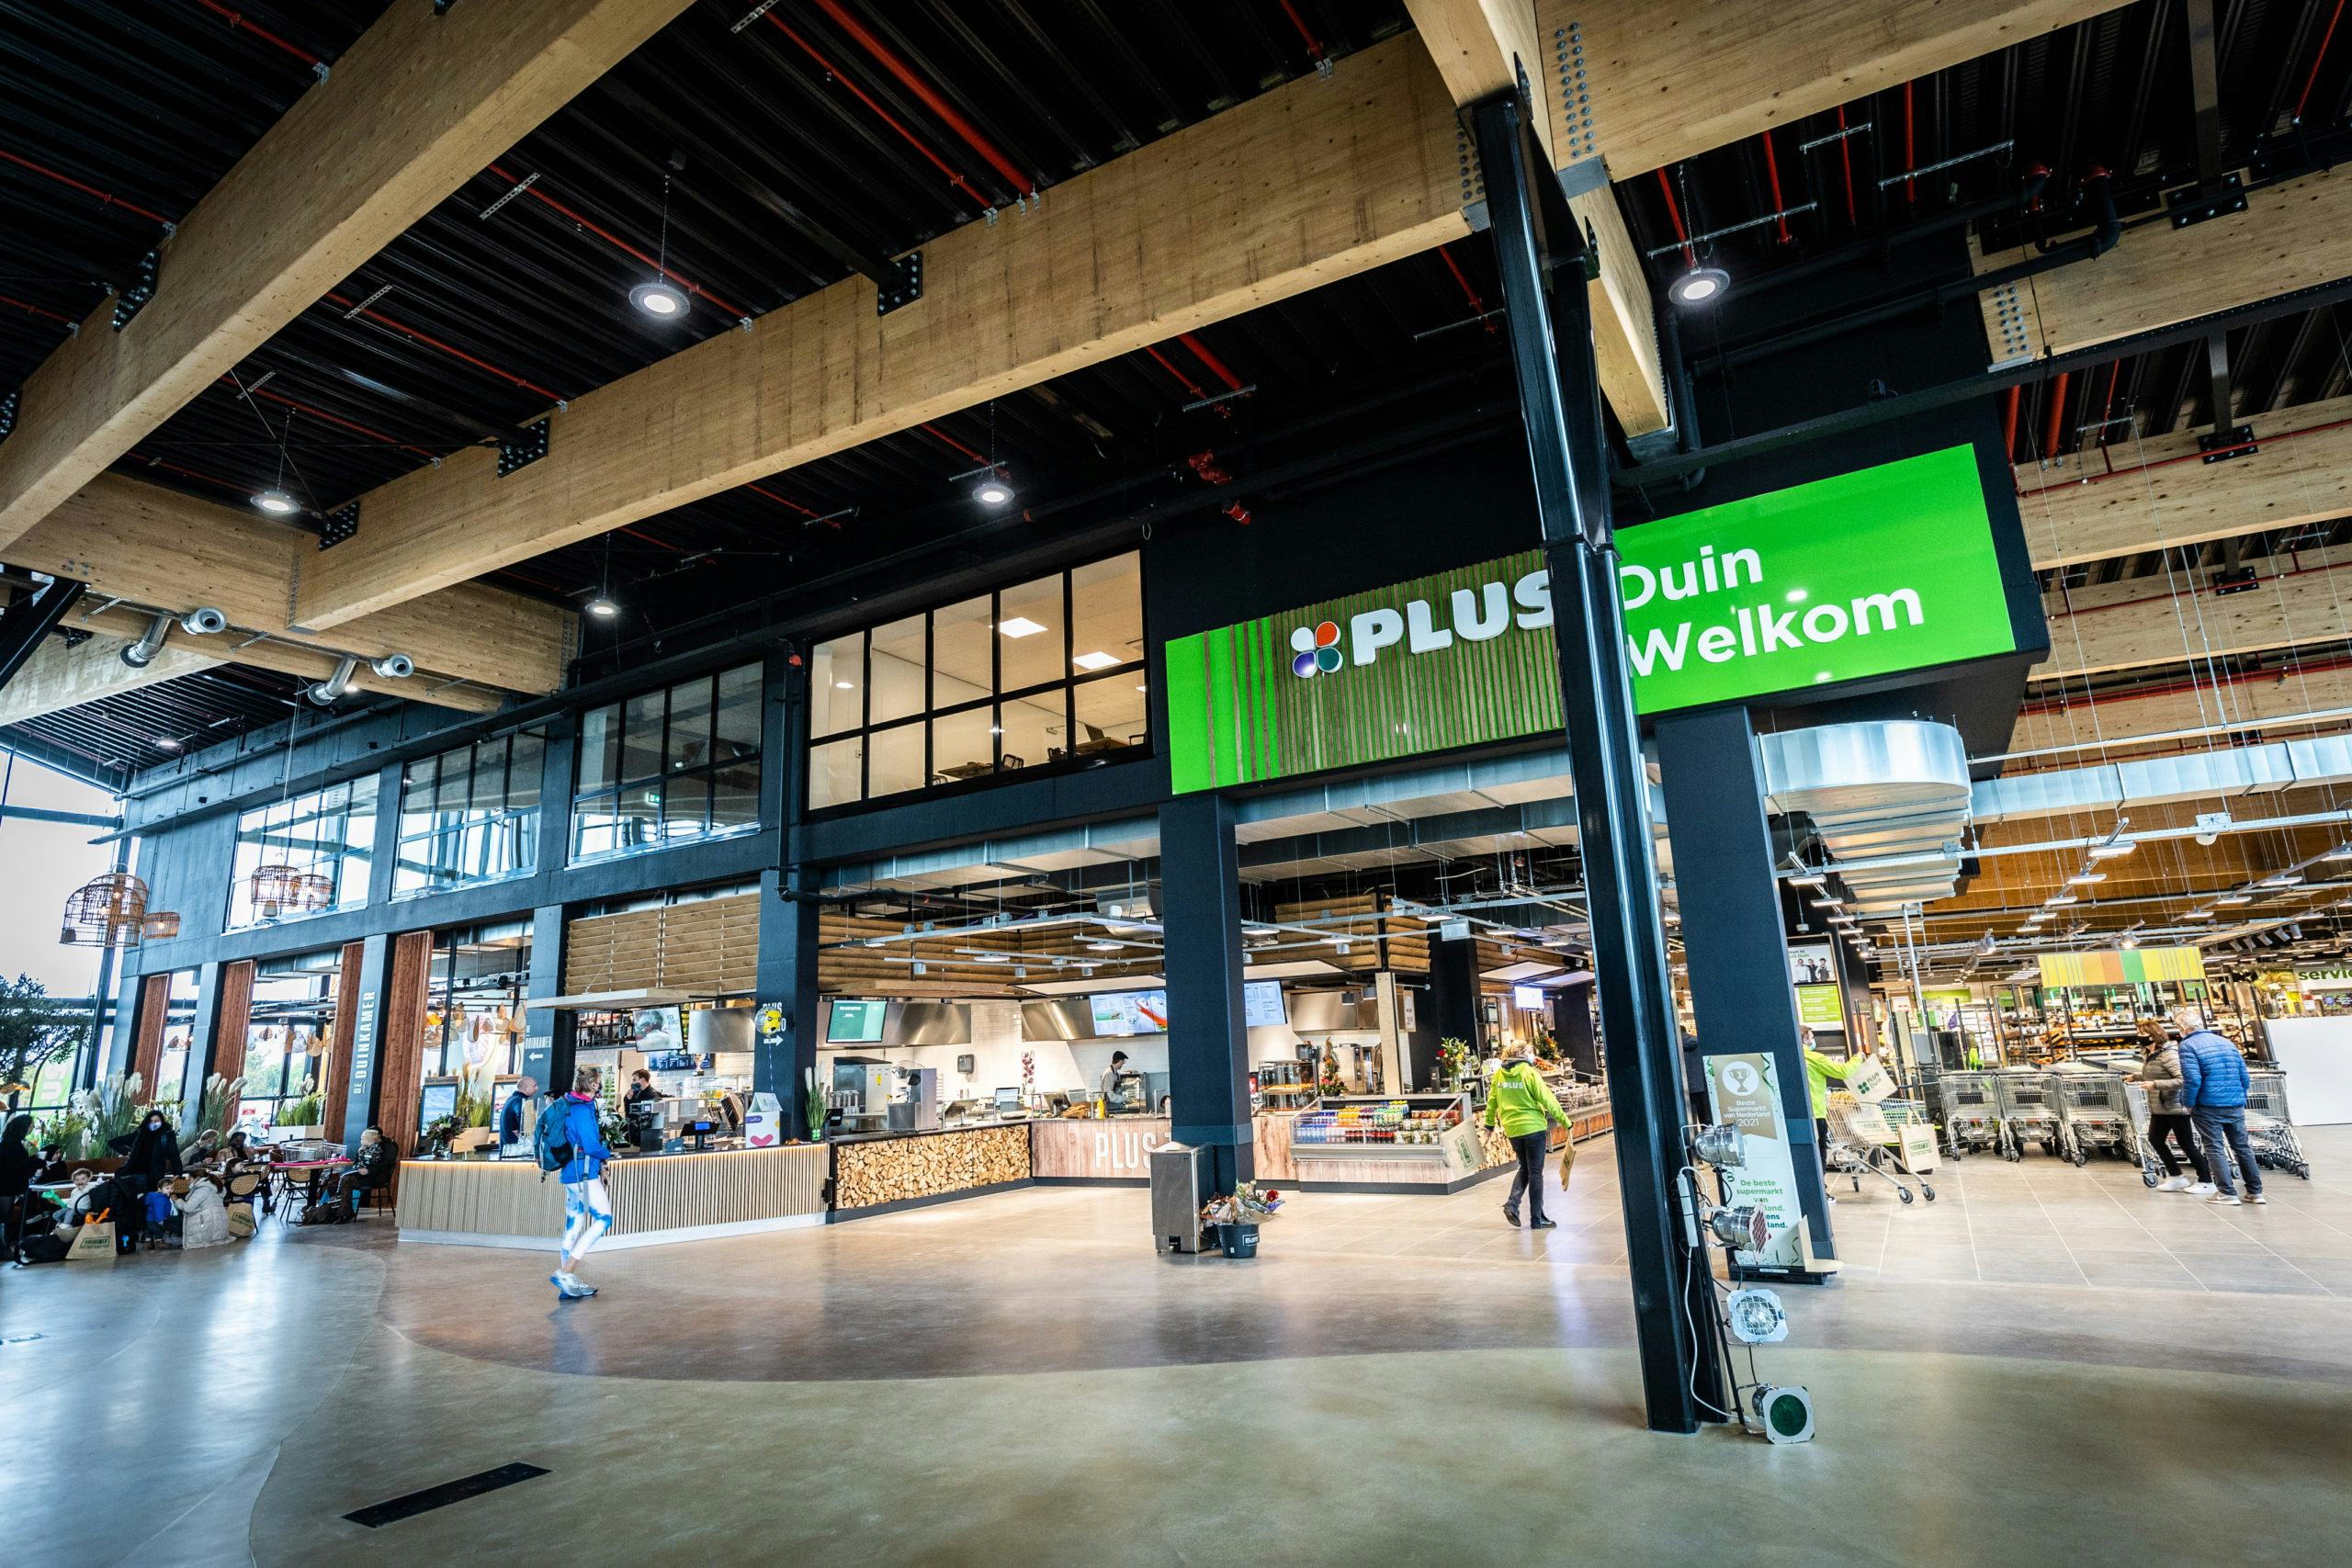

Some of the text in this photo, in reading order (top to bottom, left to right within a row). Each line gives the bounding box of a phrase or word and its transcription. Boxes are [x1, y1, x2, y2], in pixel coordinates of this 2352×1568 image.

[1620, 545, 1763, 611] Duin
[1351, 570, 1555, 667] PLUS
[1628, 588, 1925, 677] Welkom
[355, 991, 375, 1079] DUINKAMER
[1502, 1081, 1524, 1089] PLUS
[1095, 1132, 1157, 1169] PLUS
[1737, 1118, 1760, 1127] 2021
